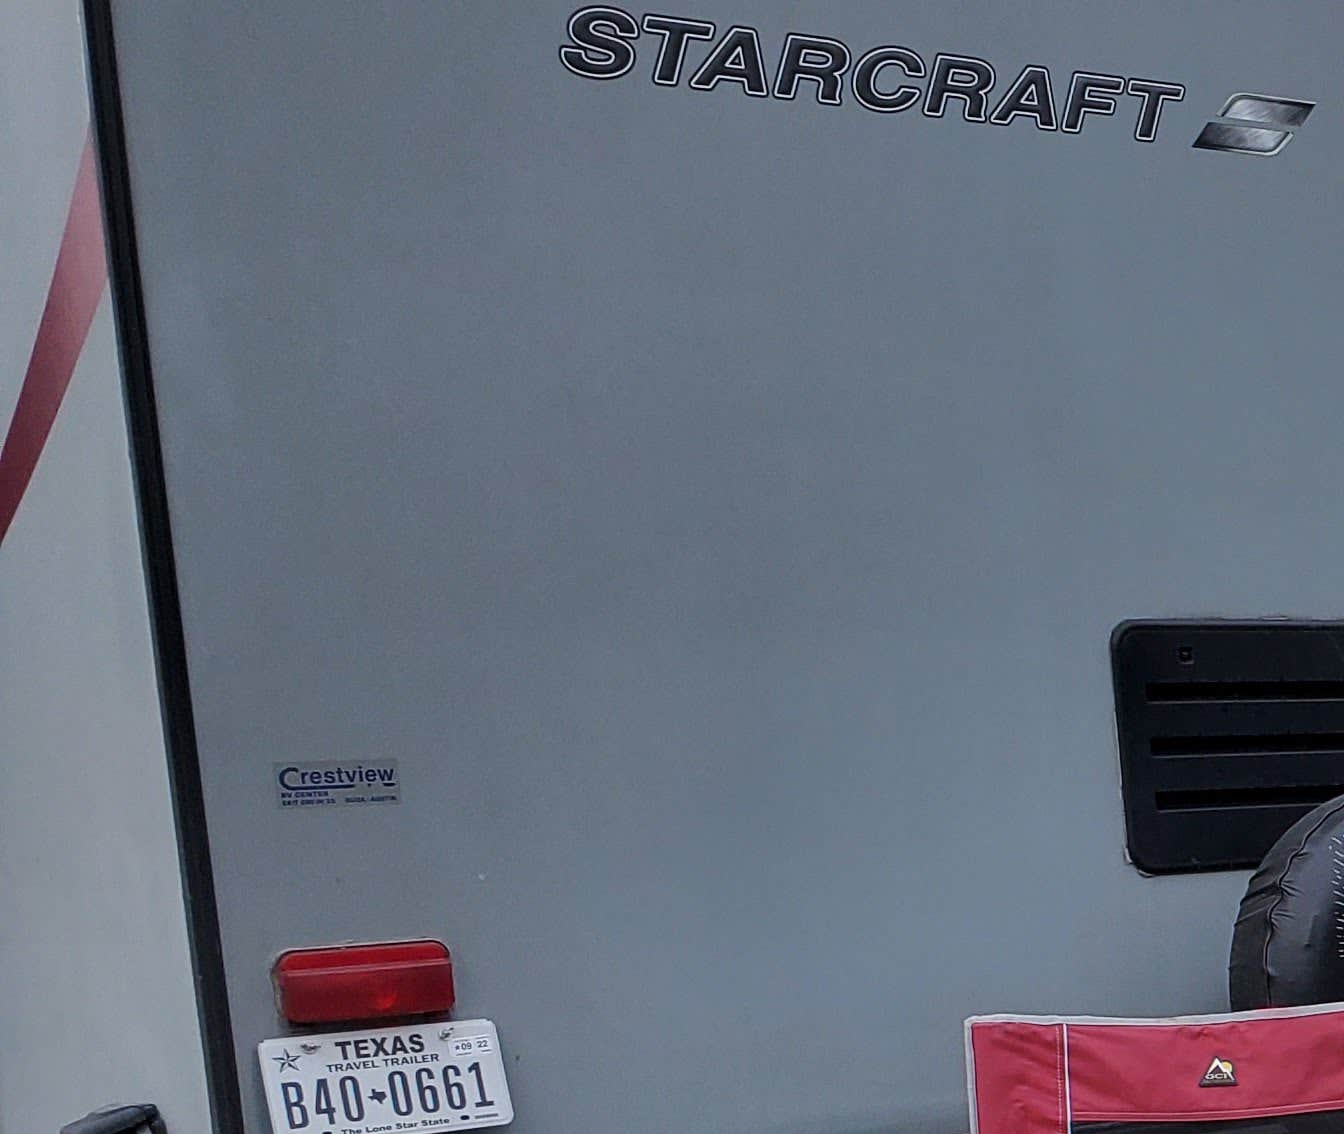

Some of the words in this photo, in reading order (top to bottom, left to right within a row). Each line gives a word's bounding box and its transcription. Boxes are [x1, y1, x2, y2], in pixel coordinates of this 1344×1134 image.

[559, 4, 1187, 143] STARCRAFT
[279, 765, 394, 791] Crestview
[334, 1033, 425, 1060] TEXAS
[326, 1058, 380, 1073] TRAVEL
[383, 1053, 440, 1067] TRAILER
[366, 1124, 392, 1134] Lone
[395, 1121, 419, 1131] Star
[421, 1117, 450, 1127] State
